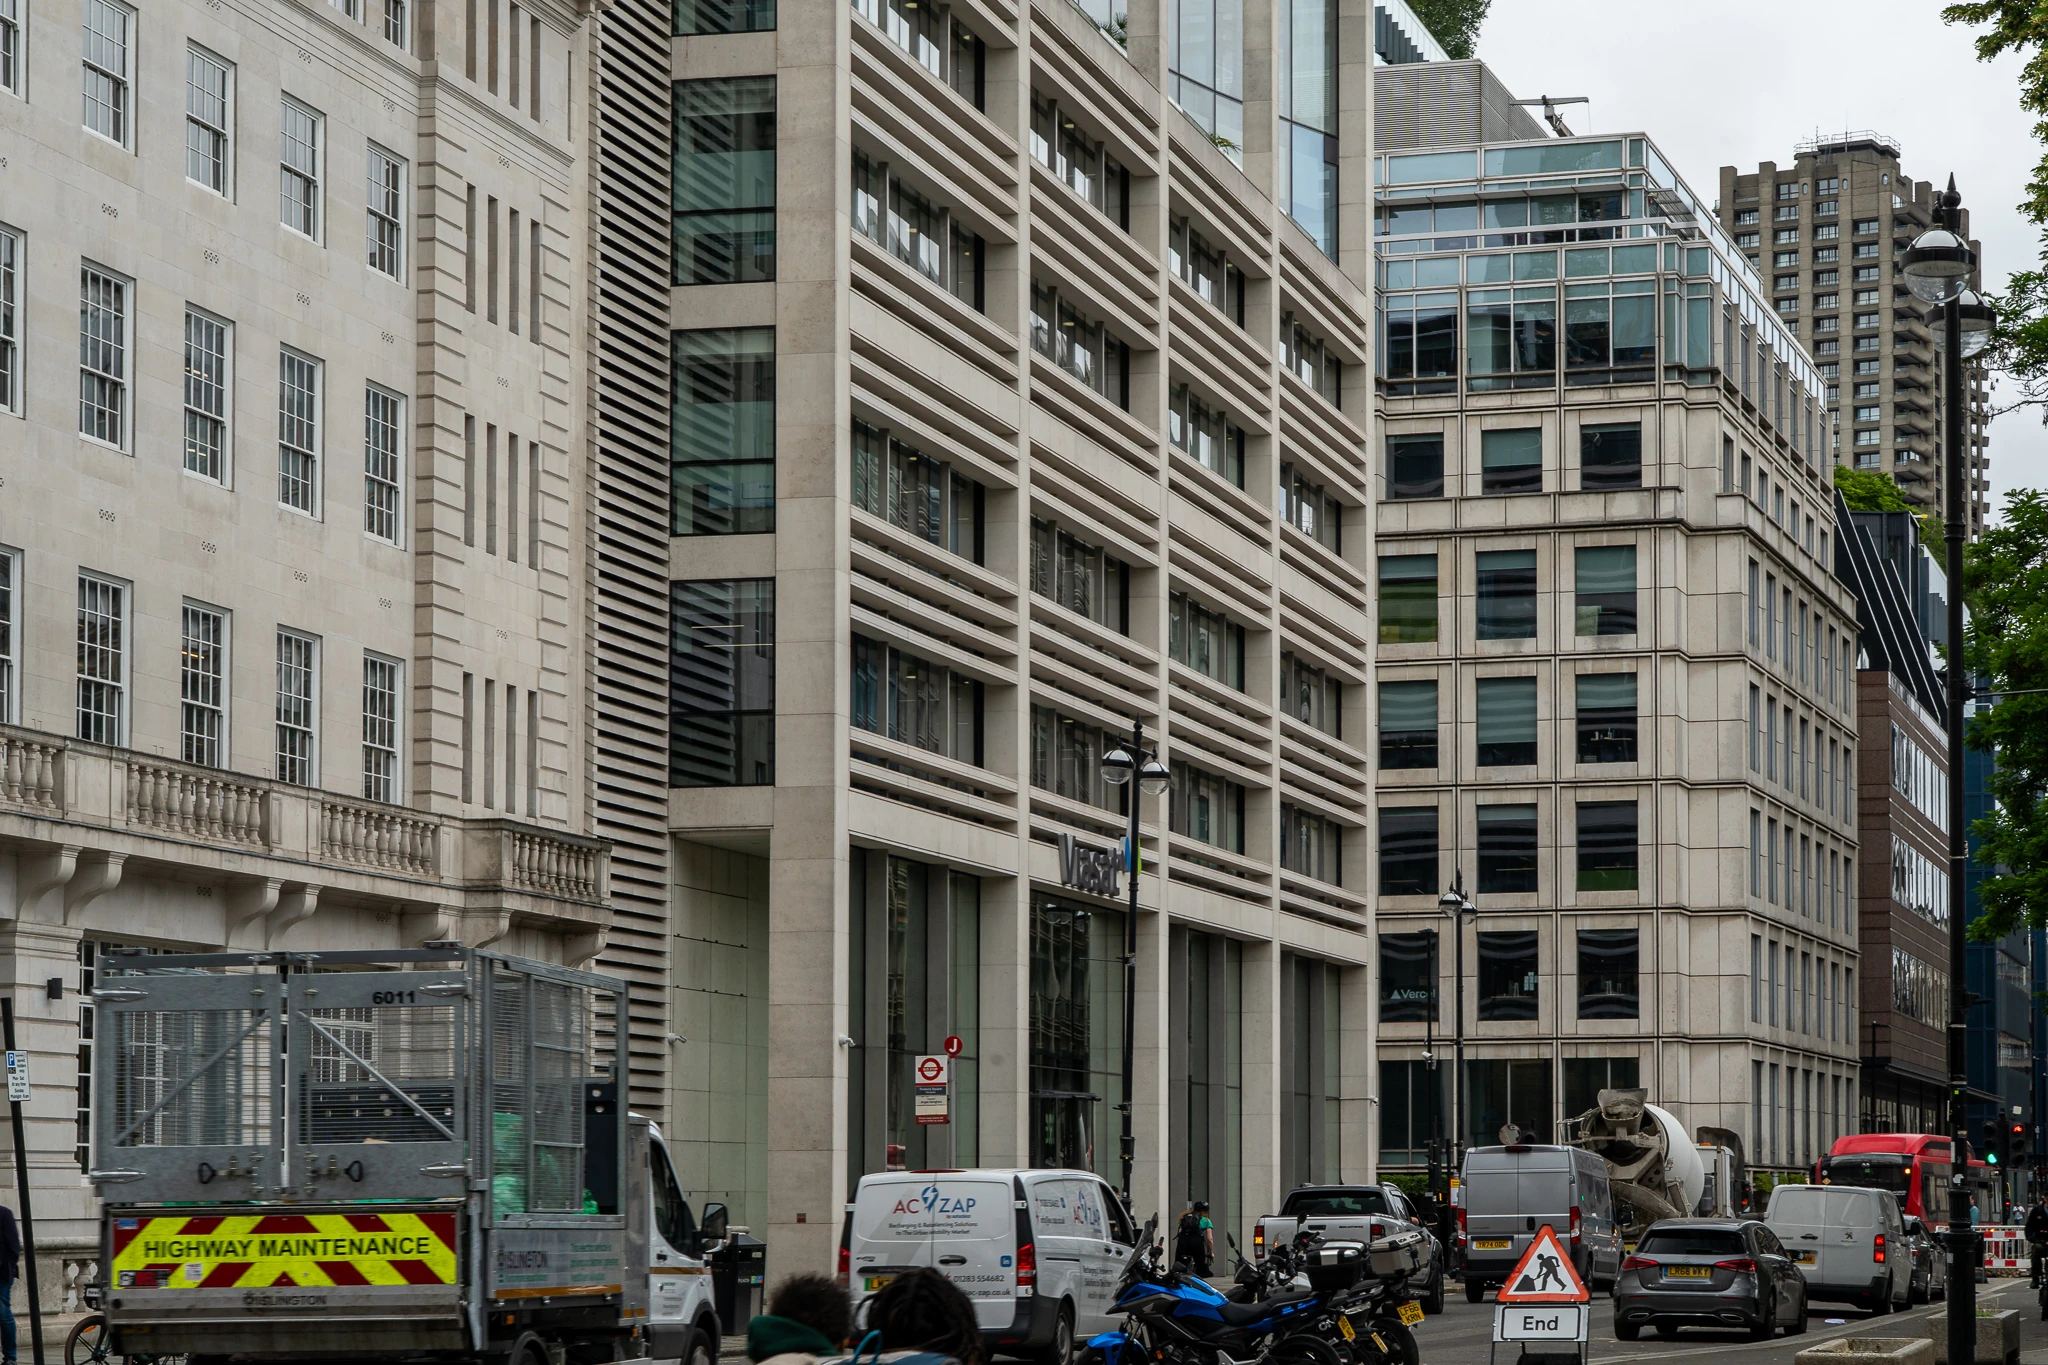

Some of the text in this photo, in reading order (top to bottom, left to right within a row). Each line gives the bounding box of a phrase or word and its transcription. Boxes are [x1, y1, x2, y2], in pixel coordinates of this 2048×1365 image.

[1058, 833, 1121, 897] Viasat
[372, 990, 415, 1004] 6011
[949, 1038, 958, 1053] J
[893, 1198, 976, 1214] AC ZAP
[144, 1237, 430, 1258] HIGHWAY MAINTENANCE
[1523, 1315, 1558, 1330] End
